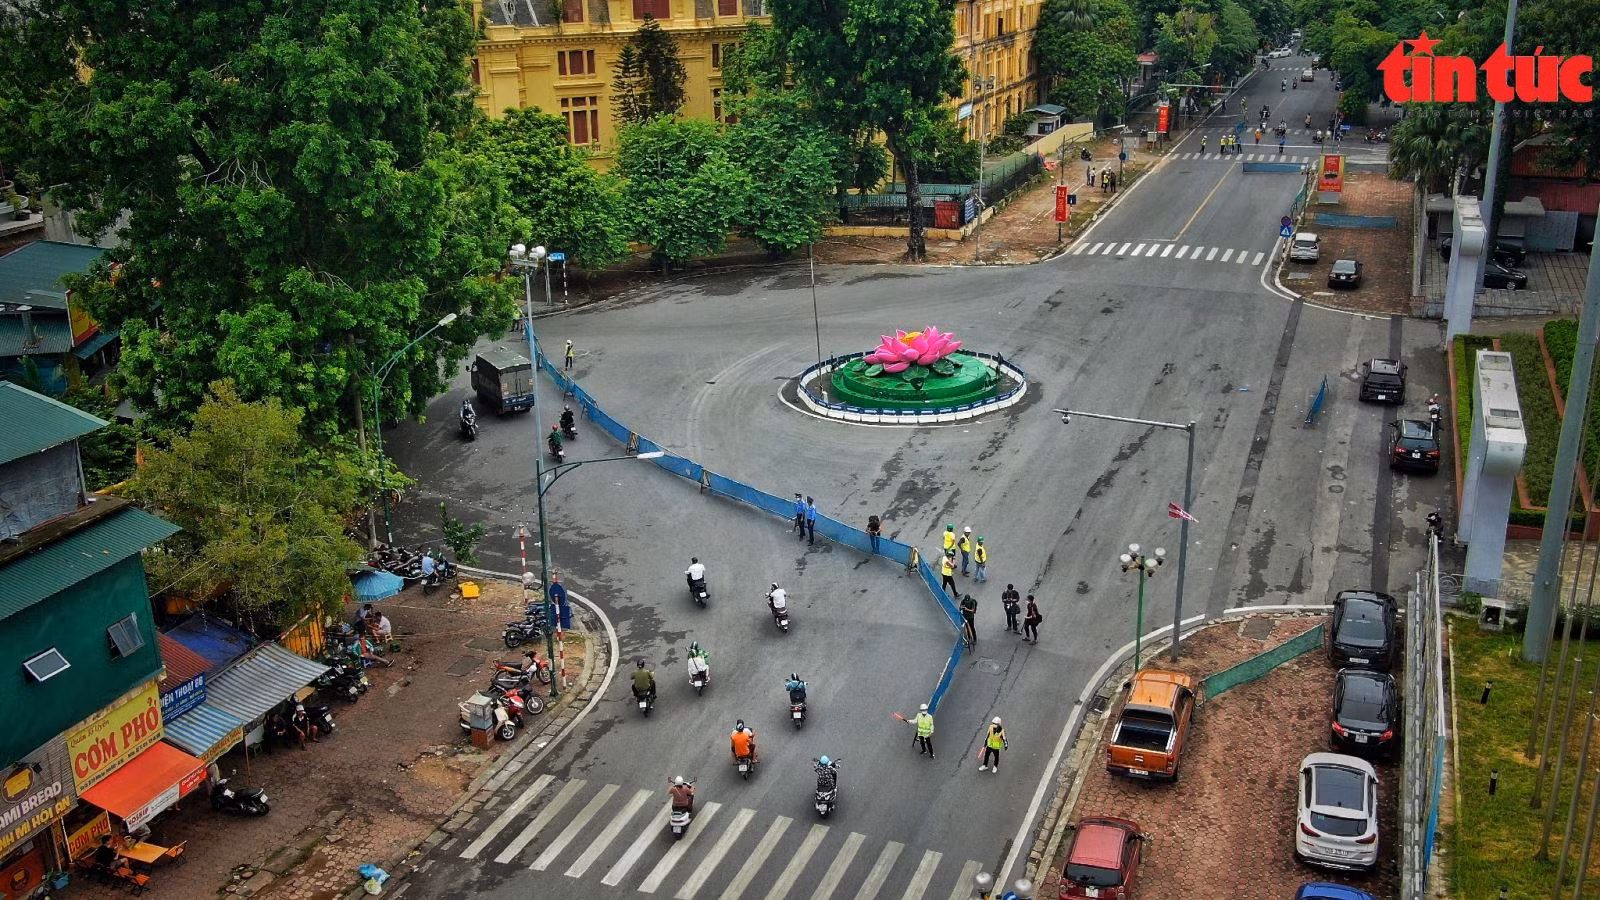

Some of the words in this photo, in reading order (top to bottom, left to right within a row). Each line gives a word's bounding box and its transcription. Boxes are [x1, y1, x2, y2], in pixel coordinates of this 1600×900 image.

[75, 732, 118, 778] CƠM
[120, 697, 159, 749] PHỞ
[21, 781, 62, 815] BREAD
[55, 795, 71, 814] AN
